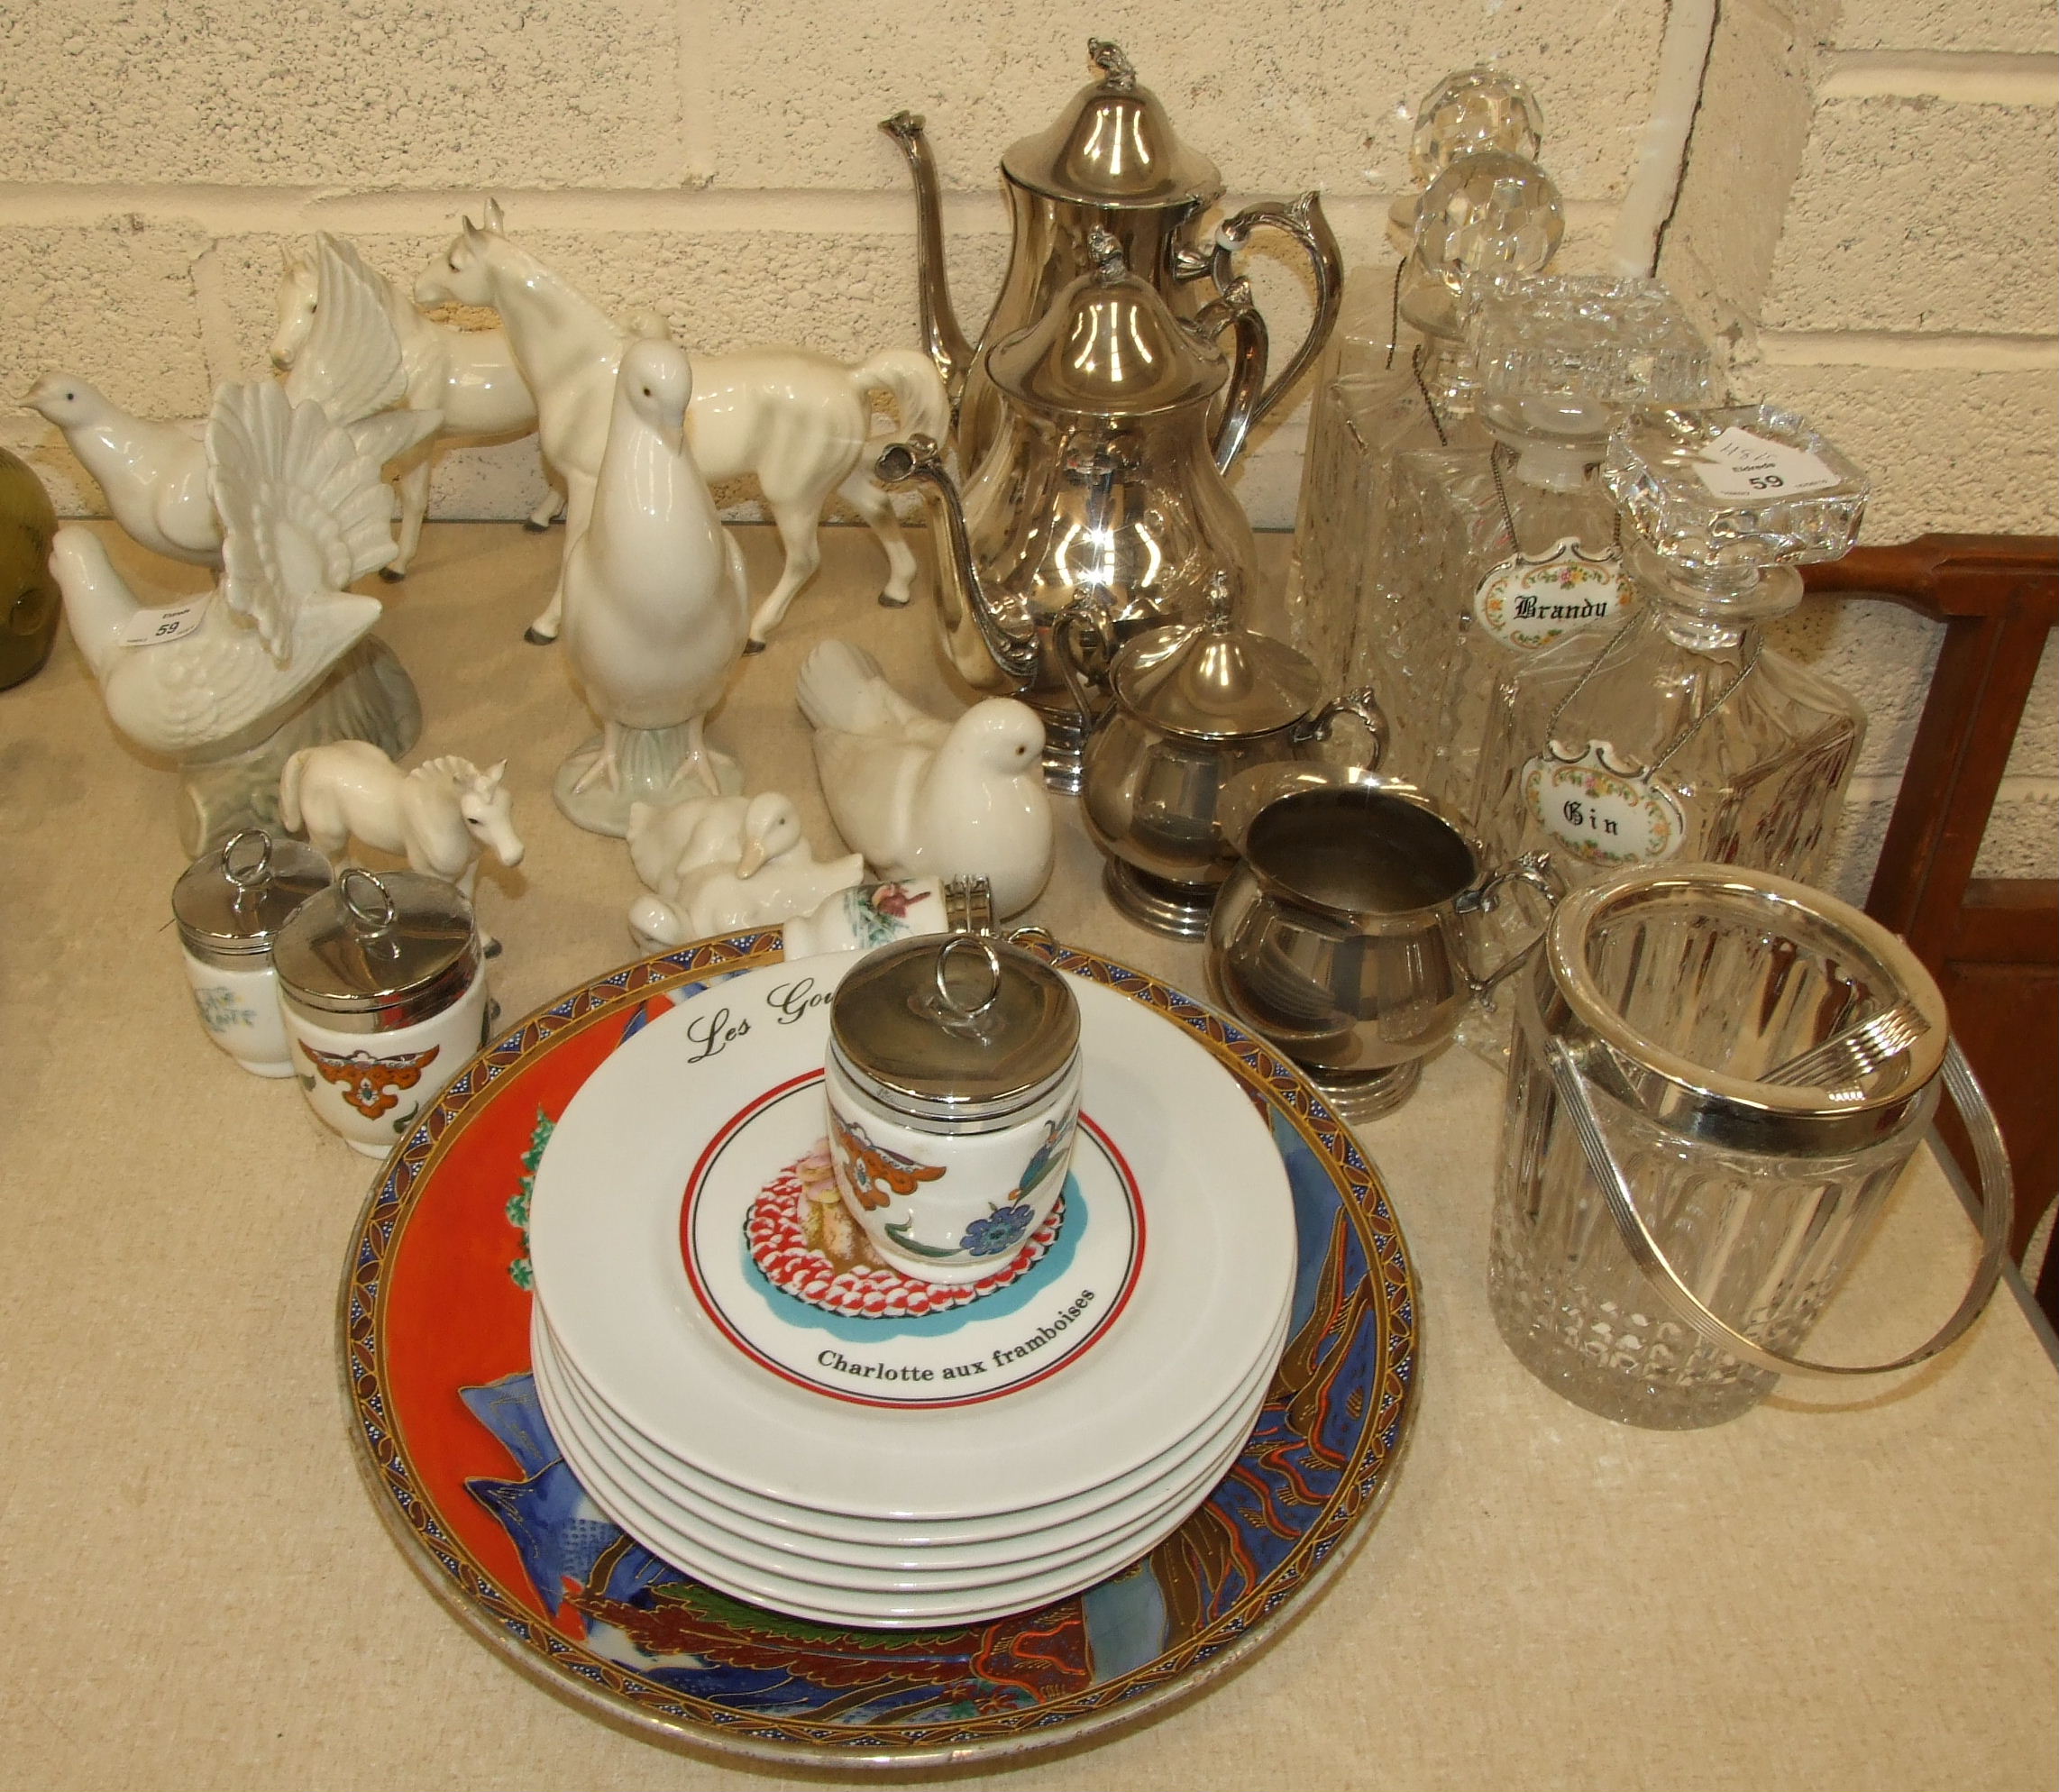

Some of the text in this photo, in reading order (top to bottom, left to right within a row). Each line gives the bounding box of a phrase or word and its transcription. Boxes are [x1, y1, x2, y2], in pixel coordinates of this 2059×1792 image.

[1749, 475, 1784, 490] 59
[1514, 595, 1608, 620] Brandy
[155, 621, 179, 636] 59
[1563, 800, 1618, 835] Gin
[687, 1008, 751, 1064] Les
[817, 1287, 1095, 1382] Charlotte aux framboises
